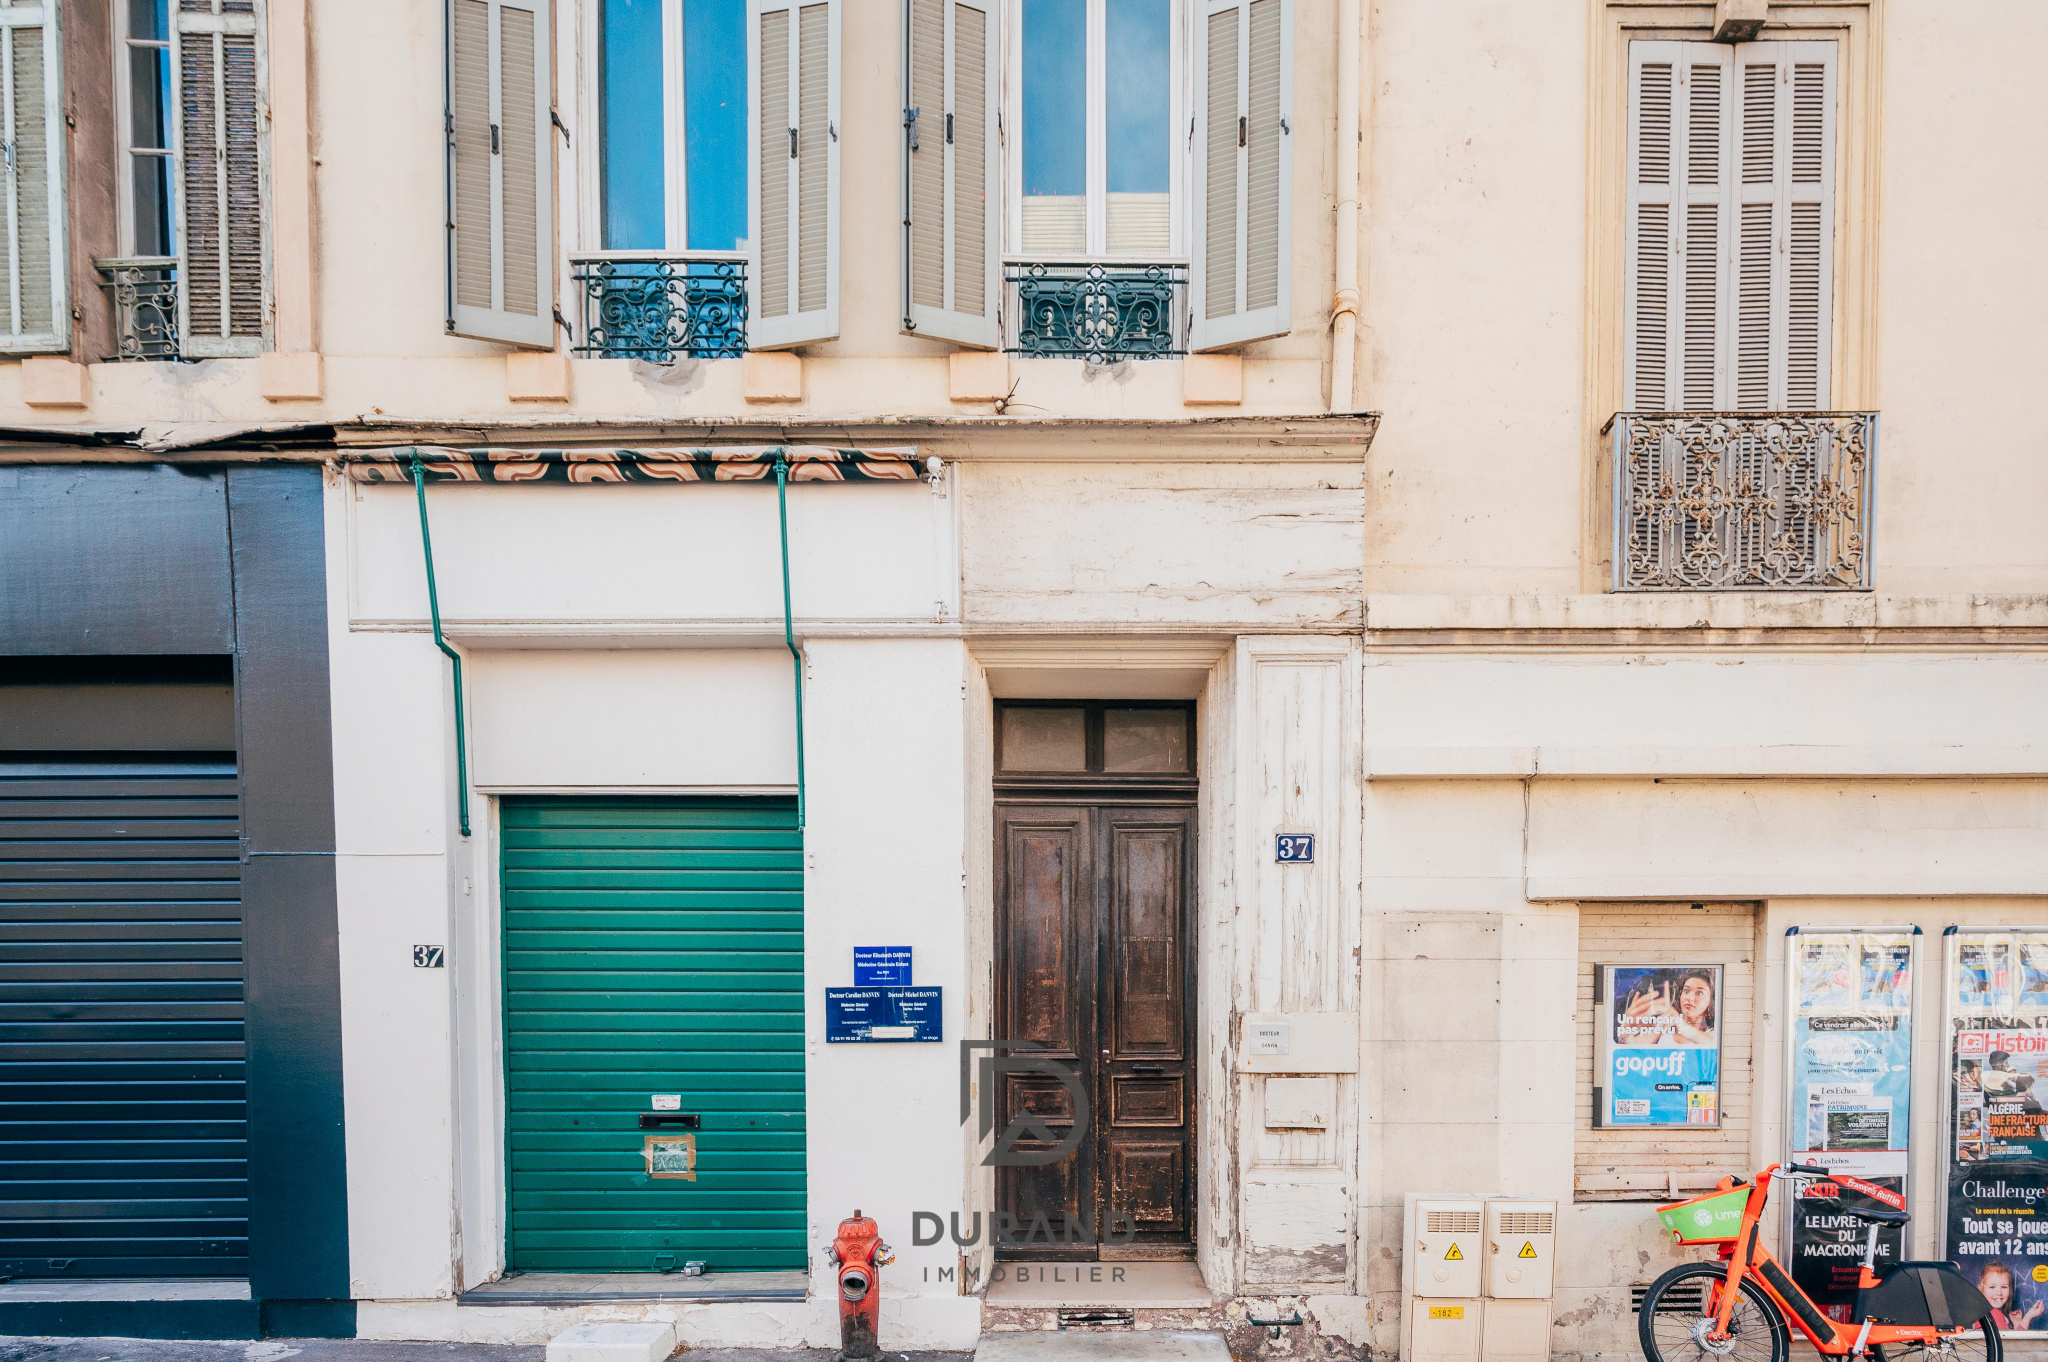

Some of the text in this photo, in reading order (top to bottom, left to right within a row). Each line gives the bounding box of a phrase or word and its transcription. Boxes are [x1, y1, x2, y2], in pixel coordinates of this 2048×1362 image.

[1280, 838, 1310, 858] 37
[414, 946, 444, 967] 37
[1617, 1014, 1634, 1024] Un
[1617, 1027, 1640, 1036] pas
[1640, 1026, 1676, 1036] prévu
[1616, 1051, 1686, 1076] gopuff
[1988, 1103, 2025, 1115] ALGÉRIE,
[1988, 1115, 2006, 1125] UNE
[1988, 1126, 2036, 1138] FRANÇAISE
[1795, 1178, 1839, 1199] FAKIR
[1847, 1178, 1901, 1206] François Ruffin
[1715, 1210, 1741, 1220] Lime
[1805, 1216, 1820, 1228] LE
[1822, 1216, 1856, 1228] LIVRE
[1962, 1218, 1993, 1234] Tout
[1997, 1221, 2013, 1234] se
[1838, 1230, 1856, 1242] DU
[1959, 1239, 2000, 1255] avant
[2005, 1239, 2022, 1255] 12
